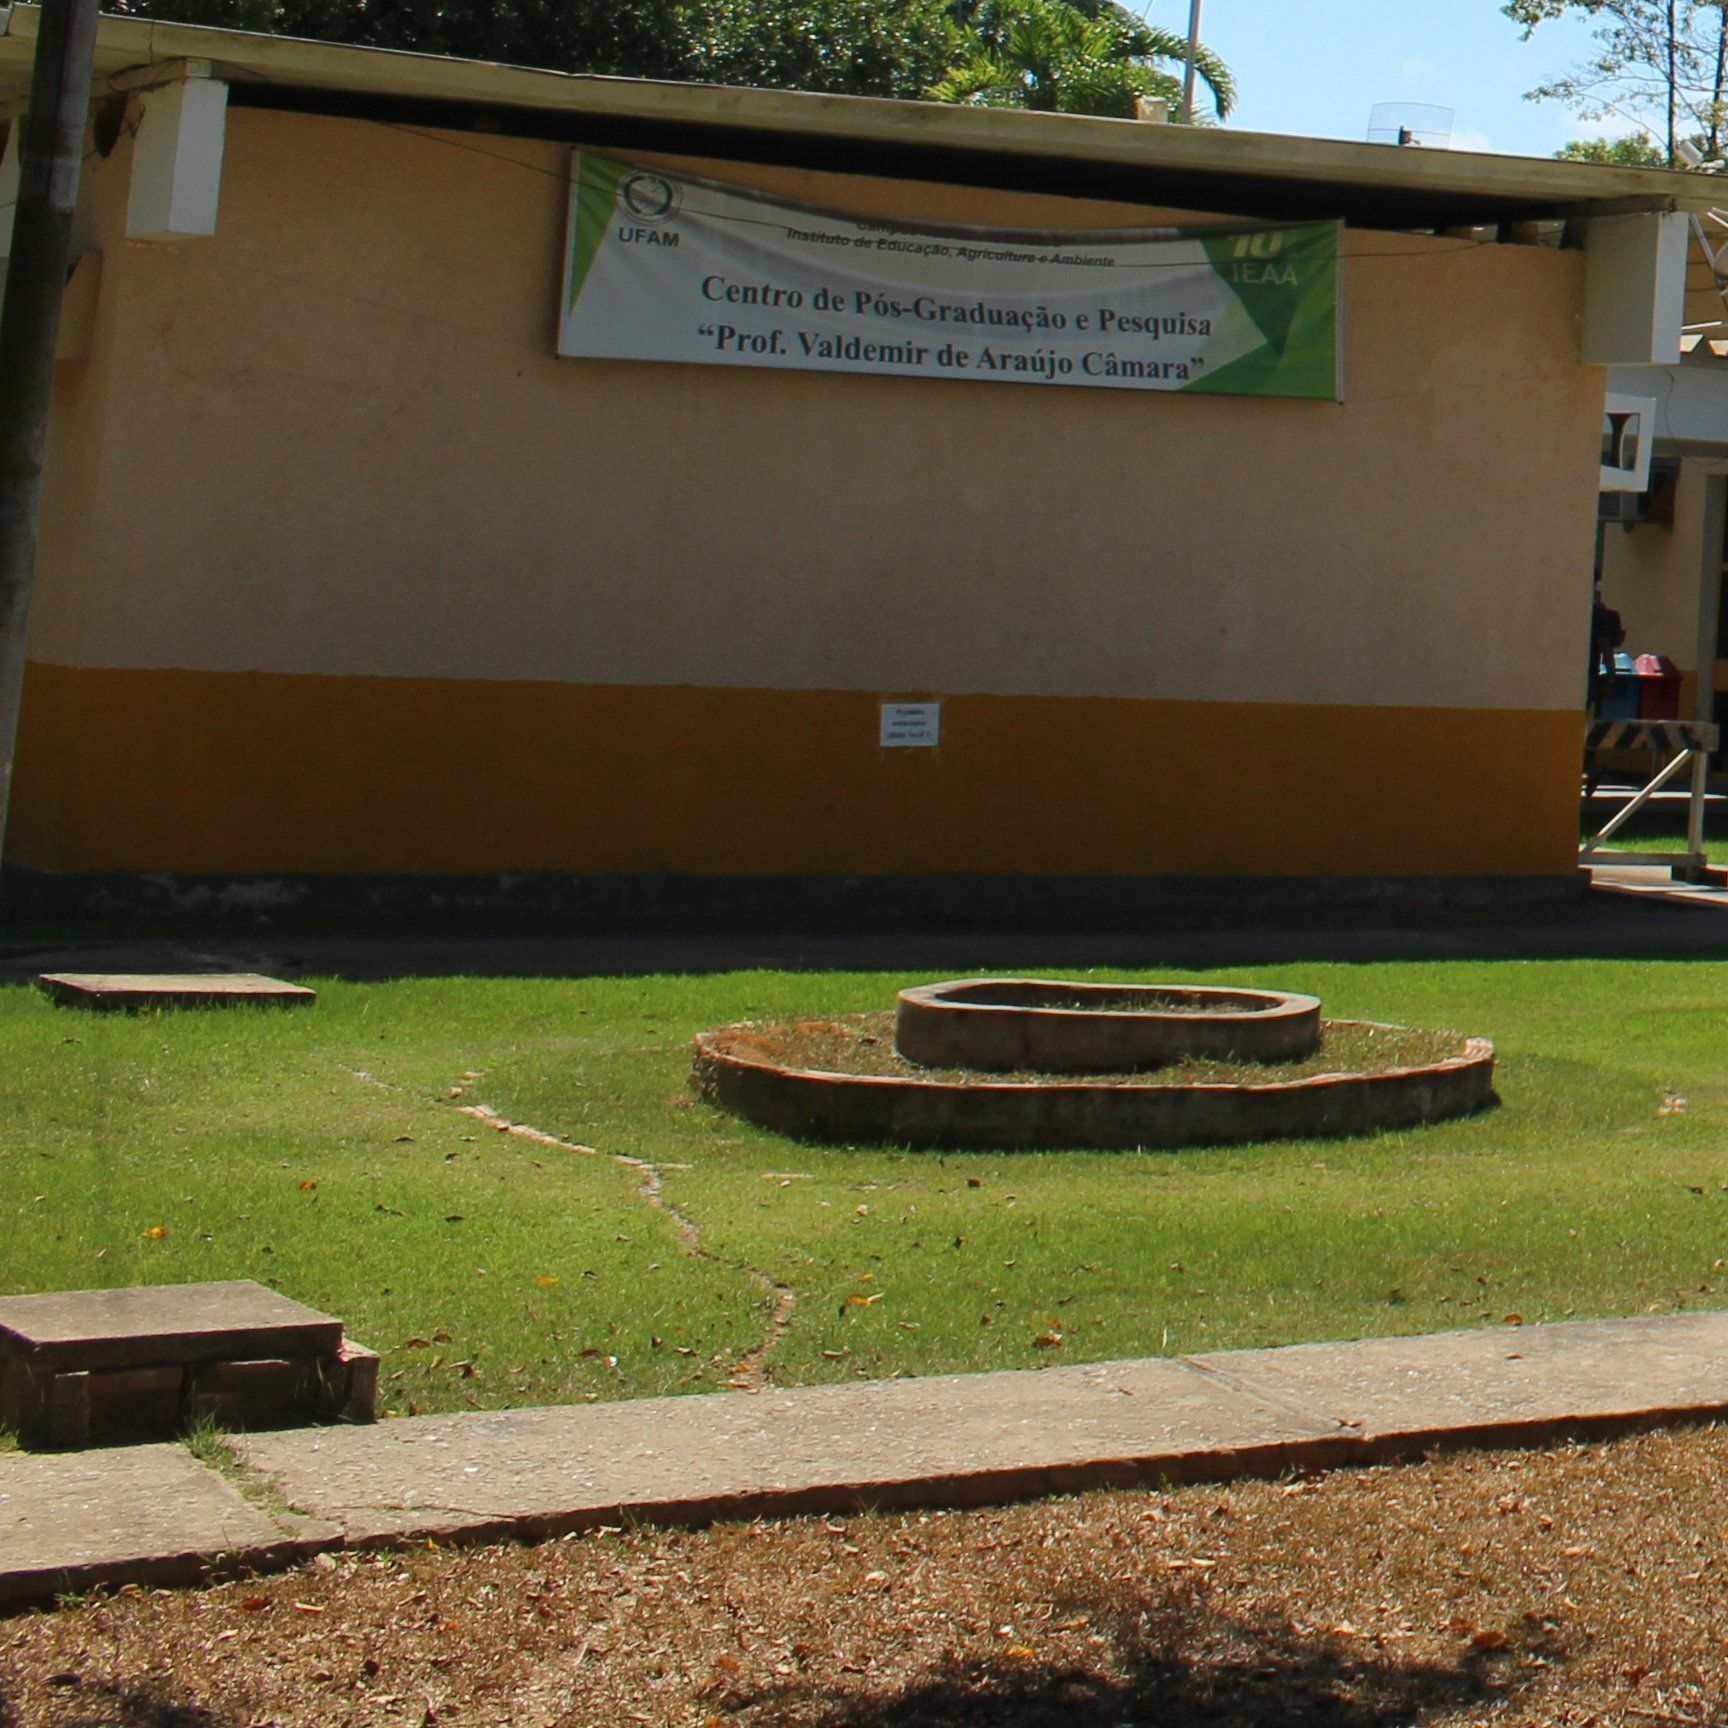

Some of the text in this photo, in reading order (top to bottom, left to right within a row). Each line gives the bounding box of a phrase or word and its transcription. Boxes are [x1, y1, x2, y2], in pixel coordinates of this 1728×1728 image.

[618, 226, 680, 248] UFAM
[785, 227, 851, 247] Instituto
[854, 235, 873, 249] de
[1050, 253, 1116, 267] Ambiente
[1233, 262, 1298, 286] IEAA
[701, 275, 1212, 341] Centro de Pós-Graduação e Pesquisa
[798, 331, 930, 366] Valdemir
[937, 344, 969, 368] de
[976, 346, 1074, 380] Araújo
